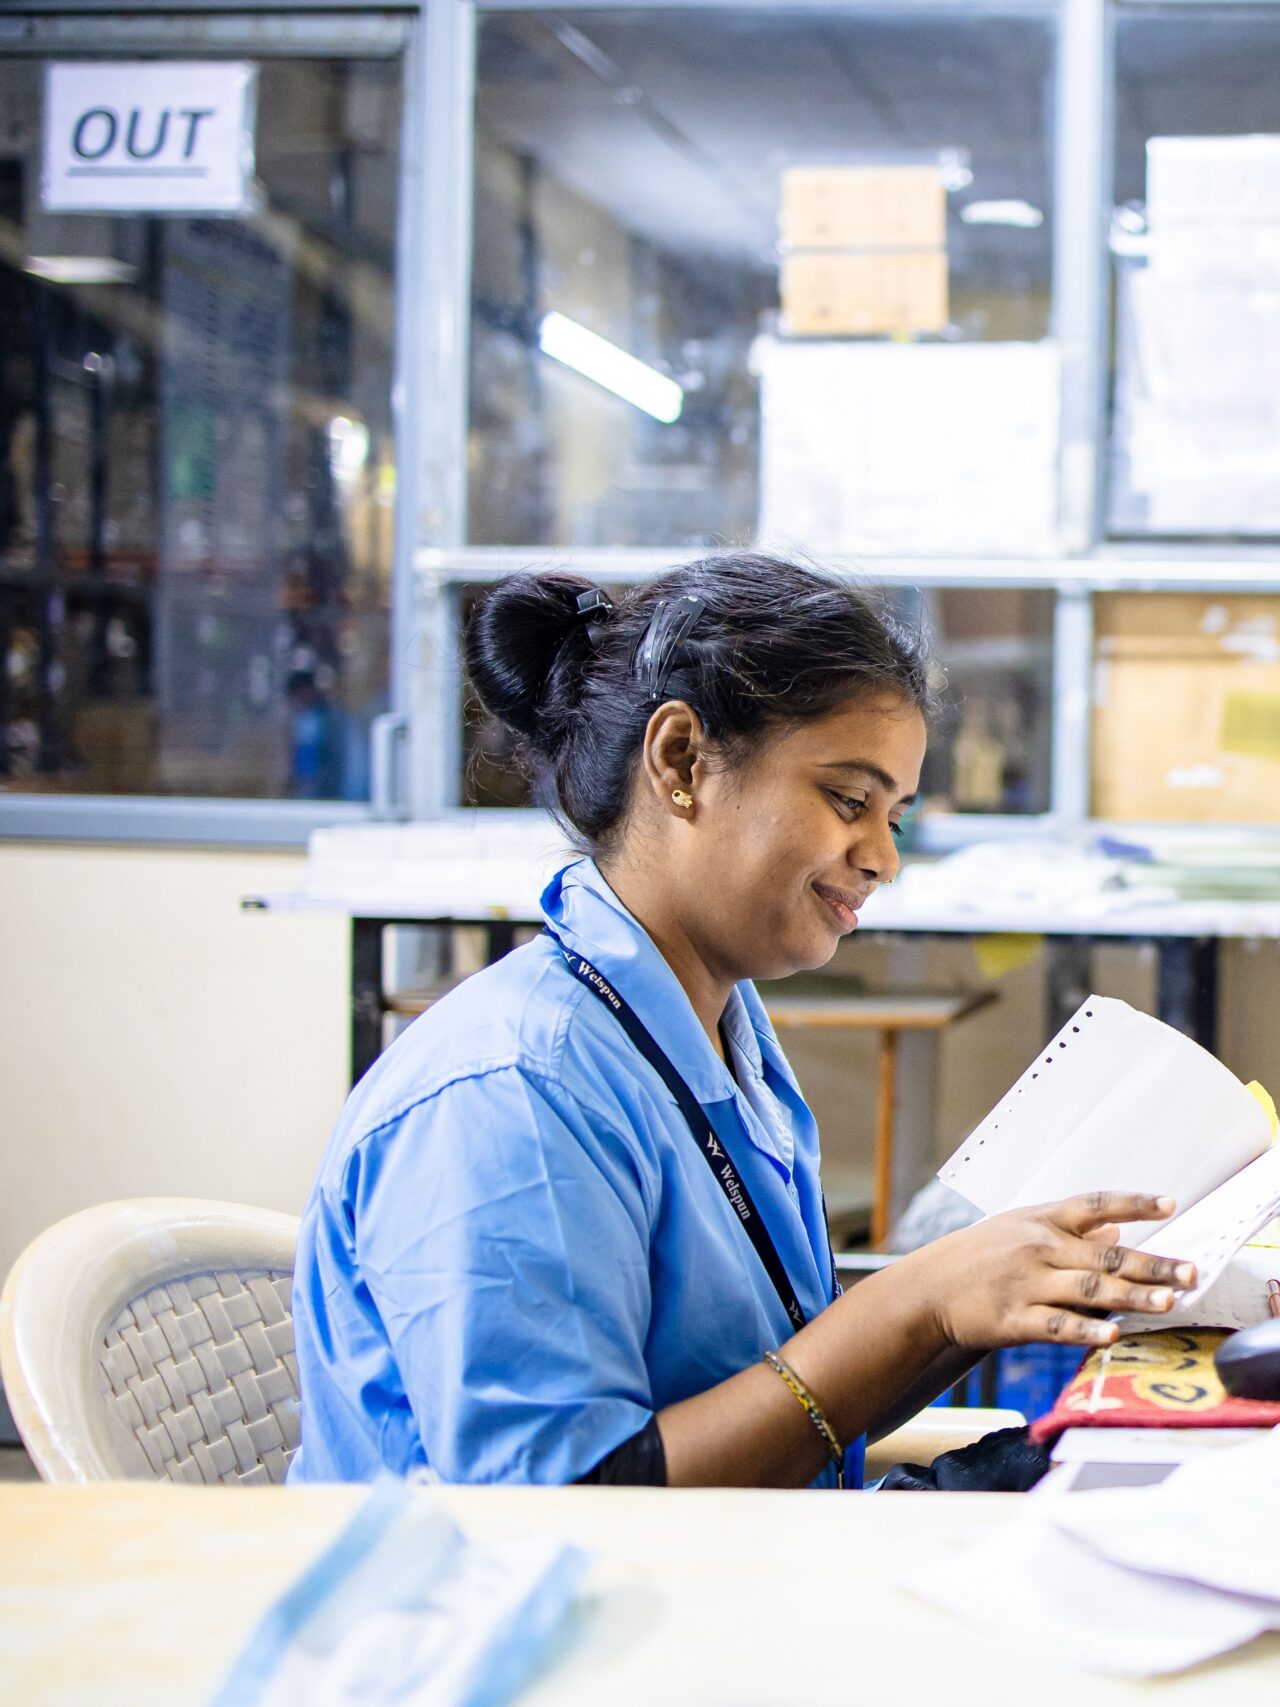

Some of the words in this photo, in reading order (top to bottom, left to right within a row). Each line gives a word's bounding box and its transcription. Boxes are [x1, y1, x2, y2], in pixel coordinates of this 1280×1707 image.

[71, 107, 217, 160] OUT
[578, 960, 621, 1010] Welspun
[721, 1163, 752, 1220] Welspun
